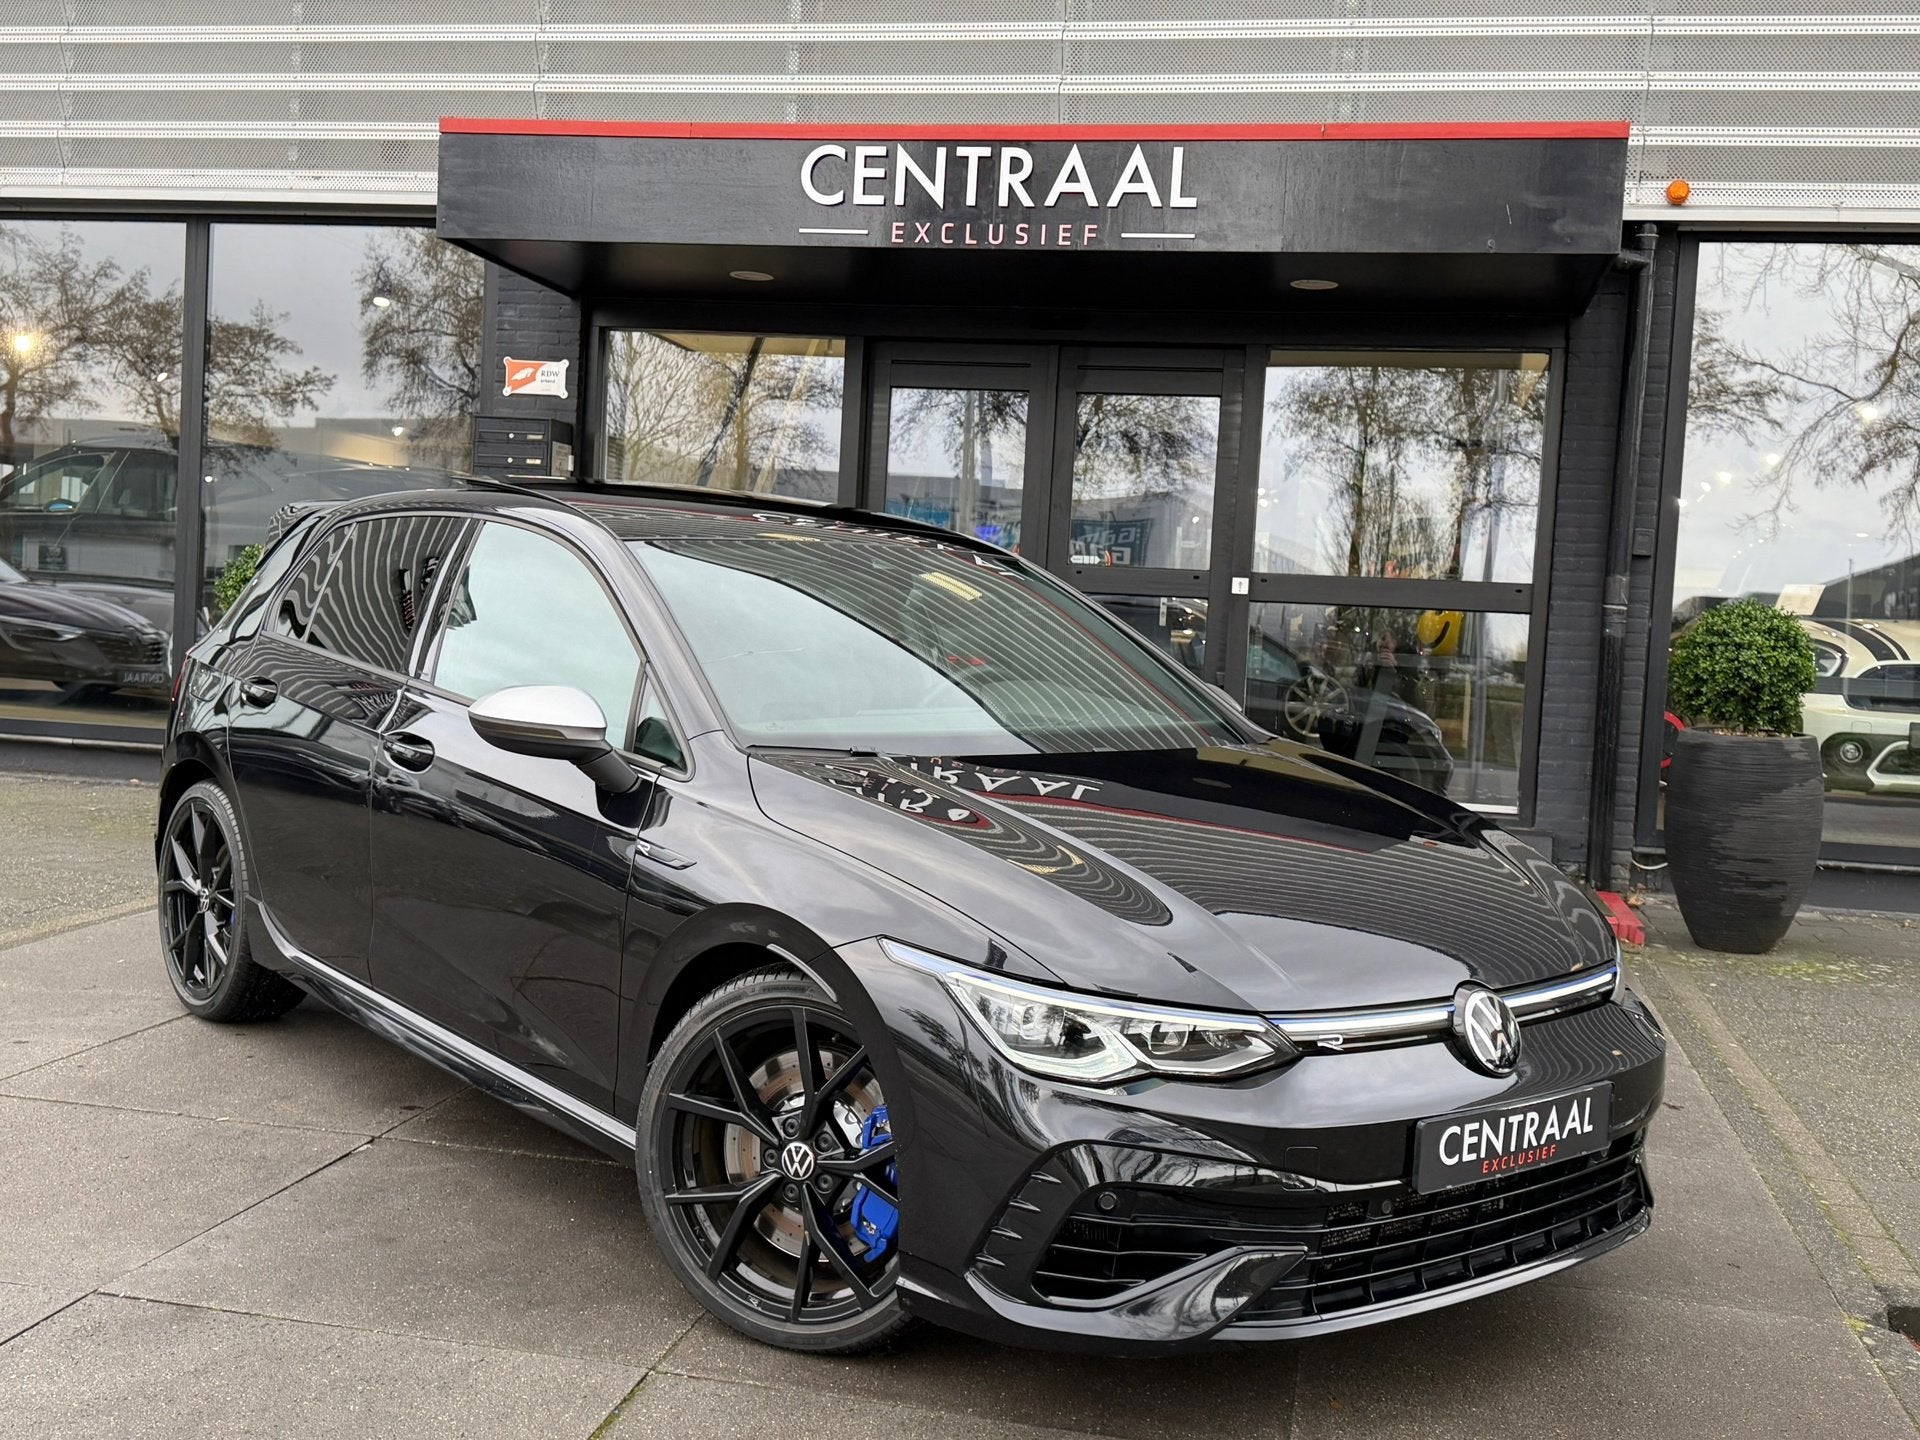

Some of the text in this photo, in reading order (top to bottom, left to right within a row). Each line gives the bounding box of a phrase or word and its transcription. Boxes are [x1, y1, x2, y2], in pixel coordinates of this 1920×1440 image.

[800, 143, 1198, 210] CENTRAAL
[890, 221, 1098, 246] EXCLUSIEF
[541, 369, 560, 377] RDW
[1439, 1096, 1594, 1167] CENTRAAL
[1482, 1143, 1558, 1175] EXCLUSIEF
